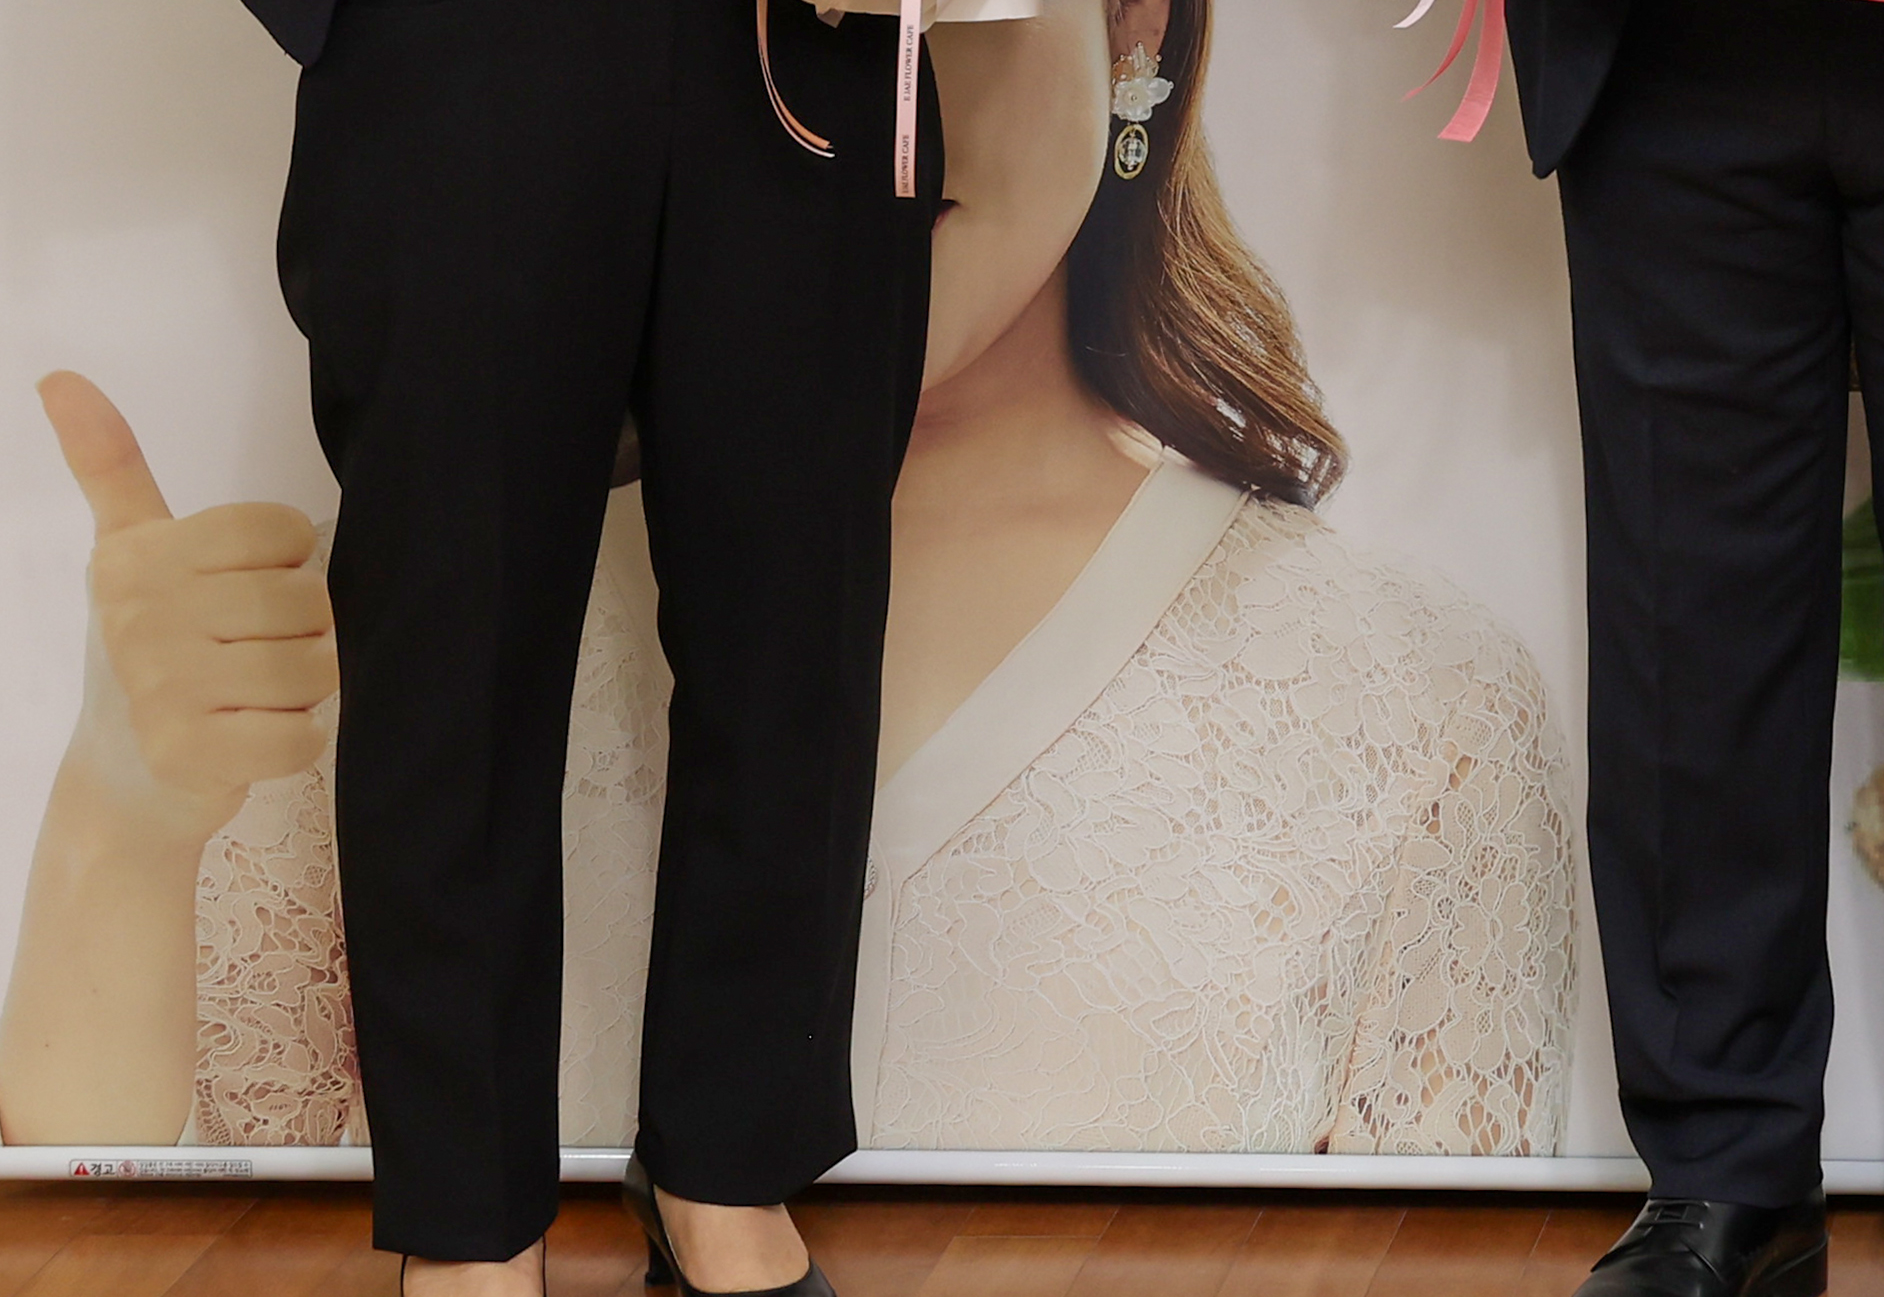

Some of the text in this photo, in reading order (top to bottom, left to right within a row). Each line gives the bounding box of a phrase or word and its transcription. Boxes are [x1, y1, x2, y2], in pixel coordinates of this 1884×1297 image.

[905, 24, 915, 46] CAFE
[904, 47, 914, 79] FLOWER
[902, 134, 911, 155] CAFE
[90, 1162, 116, 1177] 경고
